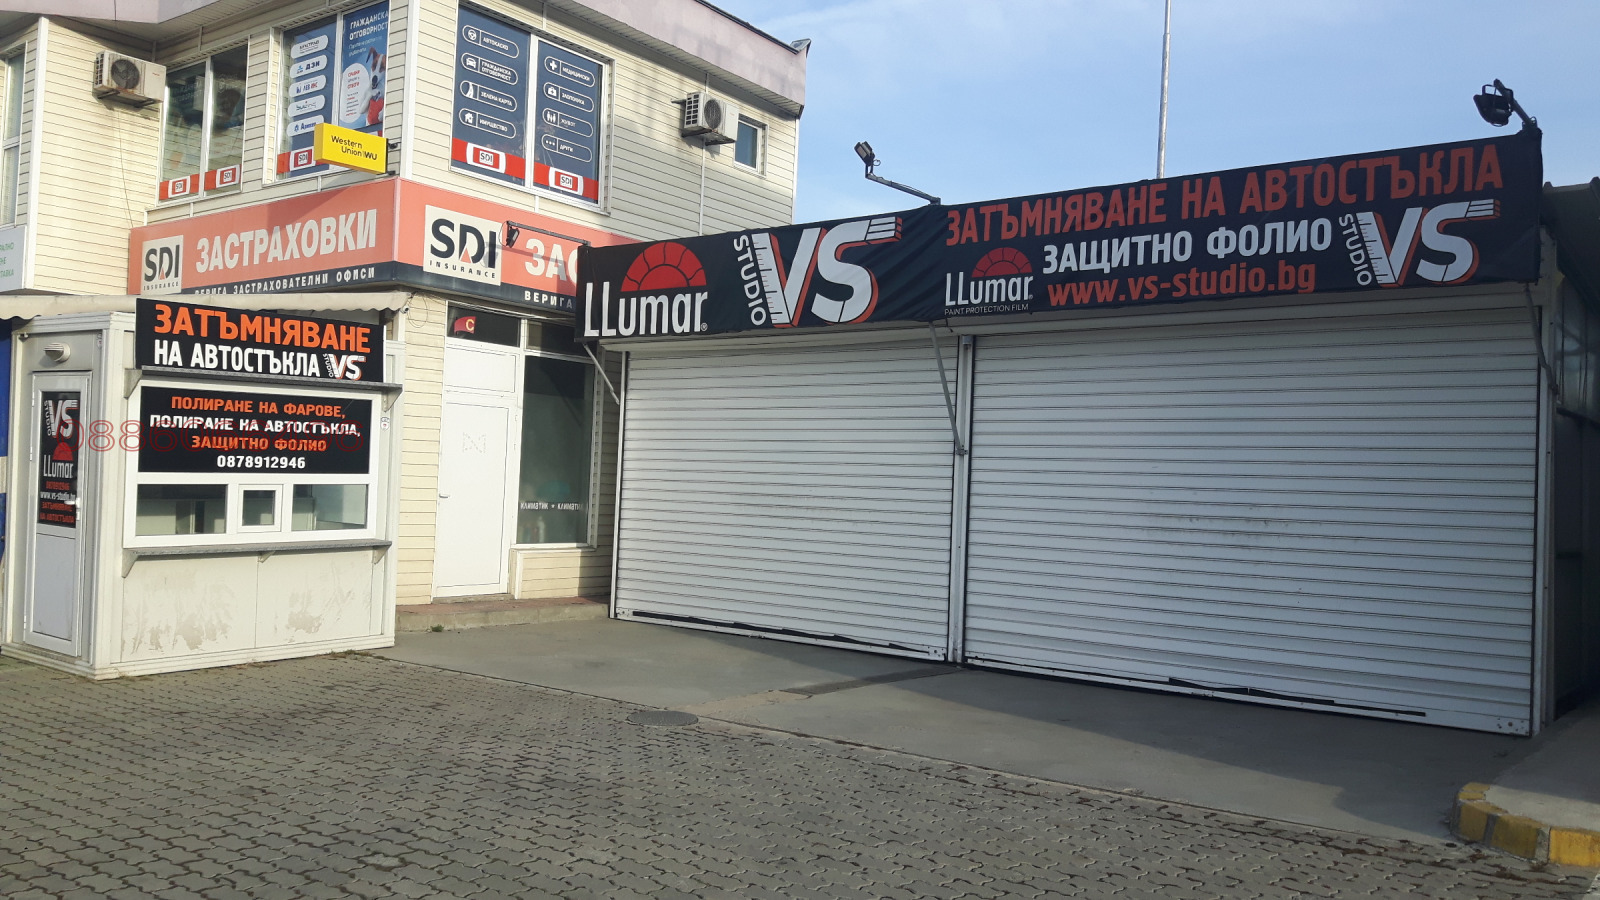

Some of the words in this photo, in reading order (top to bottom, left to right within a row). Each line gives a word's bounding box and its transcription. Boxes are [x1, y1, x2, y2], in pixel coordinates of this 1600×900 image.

[350, 10, 388, 29] ГРАЖДАНСКА
[483, 37, 508, 50] АВТОКАСКО
[482, 61, 511, 76] ГРАЖДАНСКА
[482, 67, 511, 81] ОТГОВОРНОСТ
[481, 92, 498, 101] ЗЕЛЕНА
[498, 97, 512, 106] КАРТА
[480, 119, 507, 132] ИМУЩЕСТВО
[561, 119, 576, 127] ЖИВОТ
[331, 135, 362, 149] Western
[341, 146, 362, 156] Union
[560, 144, 574, 152] ДРУГИ
[480, 152, 492, 162] SDI
[561, 176, 572, 185] SDI
[946, 183, 1167, 246] ЗАТЪМНЯВАНЕ
[1181, 176, 1226, 220] НА
[1239, 144, 1503, 214] АВТОСТЪКЛА
[196, 209, 377, 272] ЗАСТРАХОВКИ
[430, 218, 497, 269] SDI
[1043, 230, 1192, 274] ЗАЩИТНО
[1207, 218, 1332, 259] ФОЛИО
[1339, 214, 1372, 286] STUDIO
[1356, 199, 1500, 287] VS
[144, 244, 180, 282] SDI
[430, 260, 495, 279] INSURANCE
[751, 216, 902, 328] VS
[144, 281, 179, 291] INSURANCE
[234, 273, 328, 294] ЗАСТРАХОВАТЕЛНИ
[336, 267, 375, 282] ОФИСИ
[733, 234, 766, 326] STUDIO
[1048, 260, 1316, 306] www.vs-studio.bg
[524, 290, 572, 309] ВЕРИГА
[966, 305, 1010, 314] PROTECTION
[154, 304, 371, 353] ЗАТЪМНЯВАНЕ
[154, 339, 183, 367] НА
[190, 342, 320, 377] АВТОСТЪКЛА
[322, 353, 334, 378] STUDIO
[328, 353, 367, 380] VS
[48, 400, 78, 438] VS
[171, 396, 253, 413] ПОЛИРАНЕ
[259, 401, 278, 414] НА
[283, 403, 346, 419] ФАРОВЕ,
[150, 414, 234, 431] ПОЛИРАНЕ
[239, 419, 259, 431] НА
[264, 420, 361, 437] АВТОСТЪКЛА,
[192, 435, 269, 450] ЗАЩИТНО
[274, 438, 327, 451] ФОЛИО
[43, 455, 73, 478] LLumar
[217, 455, 306, 469] 0878912946
